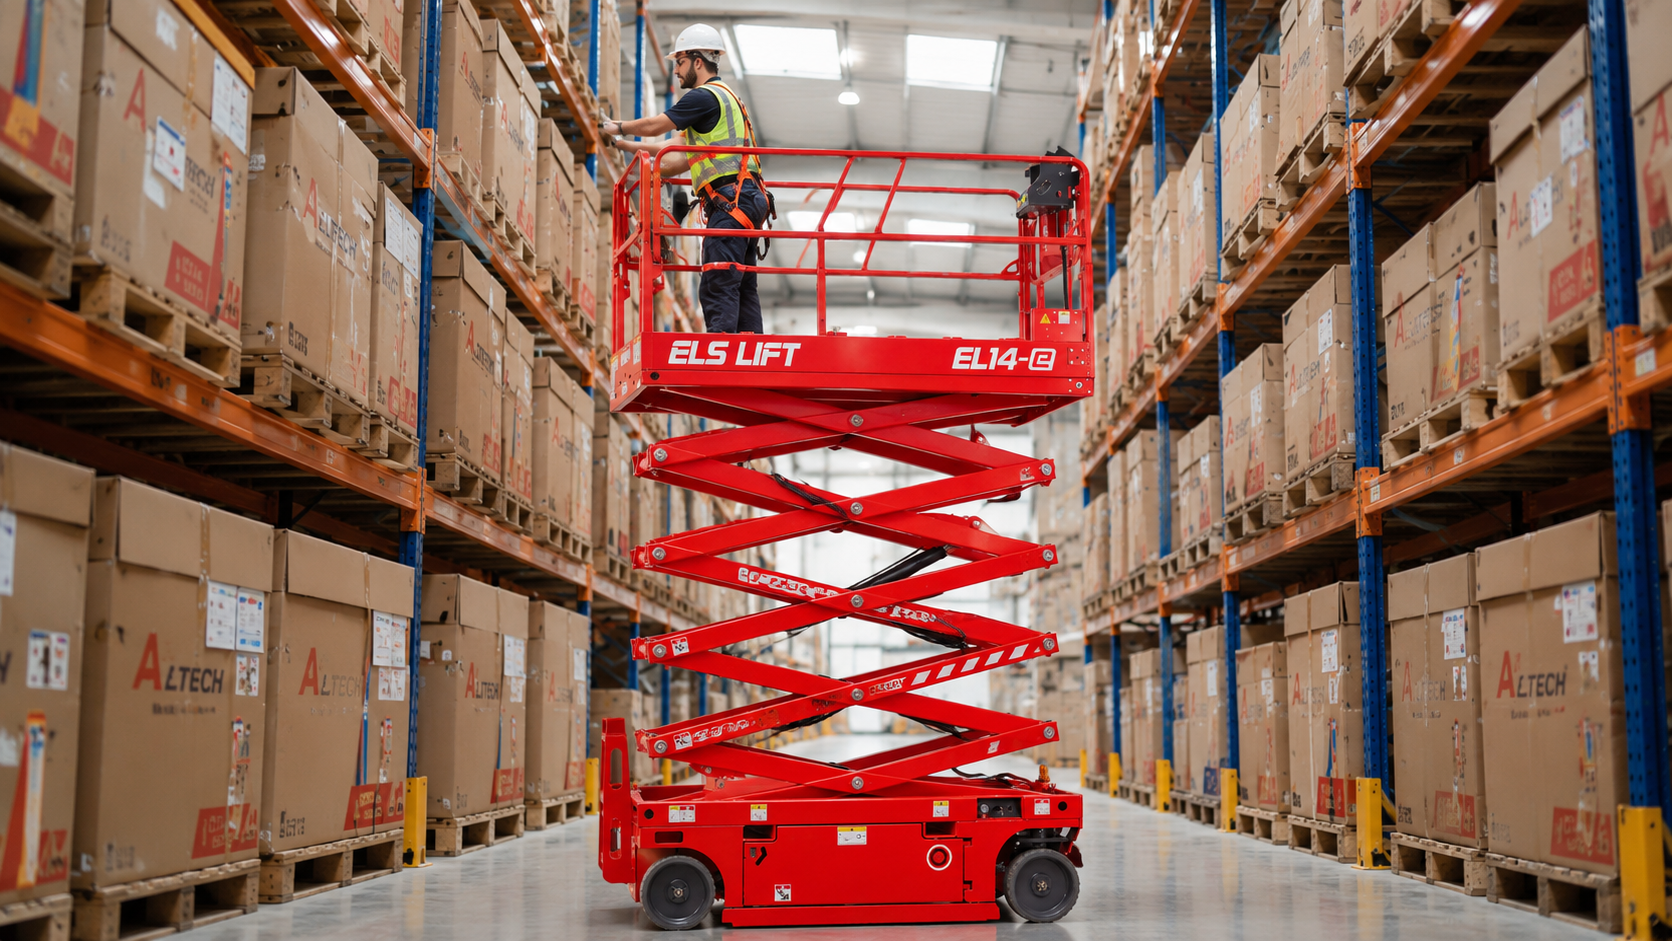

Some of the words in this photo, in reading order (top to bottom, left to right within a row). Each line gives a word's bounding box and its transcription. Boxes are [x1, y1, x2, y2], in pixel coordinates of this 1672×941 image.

[668, 340, 730, 365] ELS
[735, 341, 802, 367] LIFT
[132, 632, 225, 695] ALTECH
[1496, 650, 1567, 699] ALTECH
